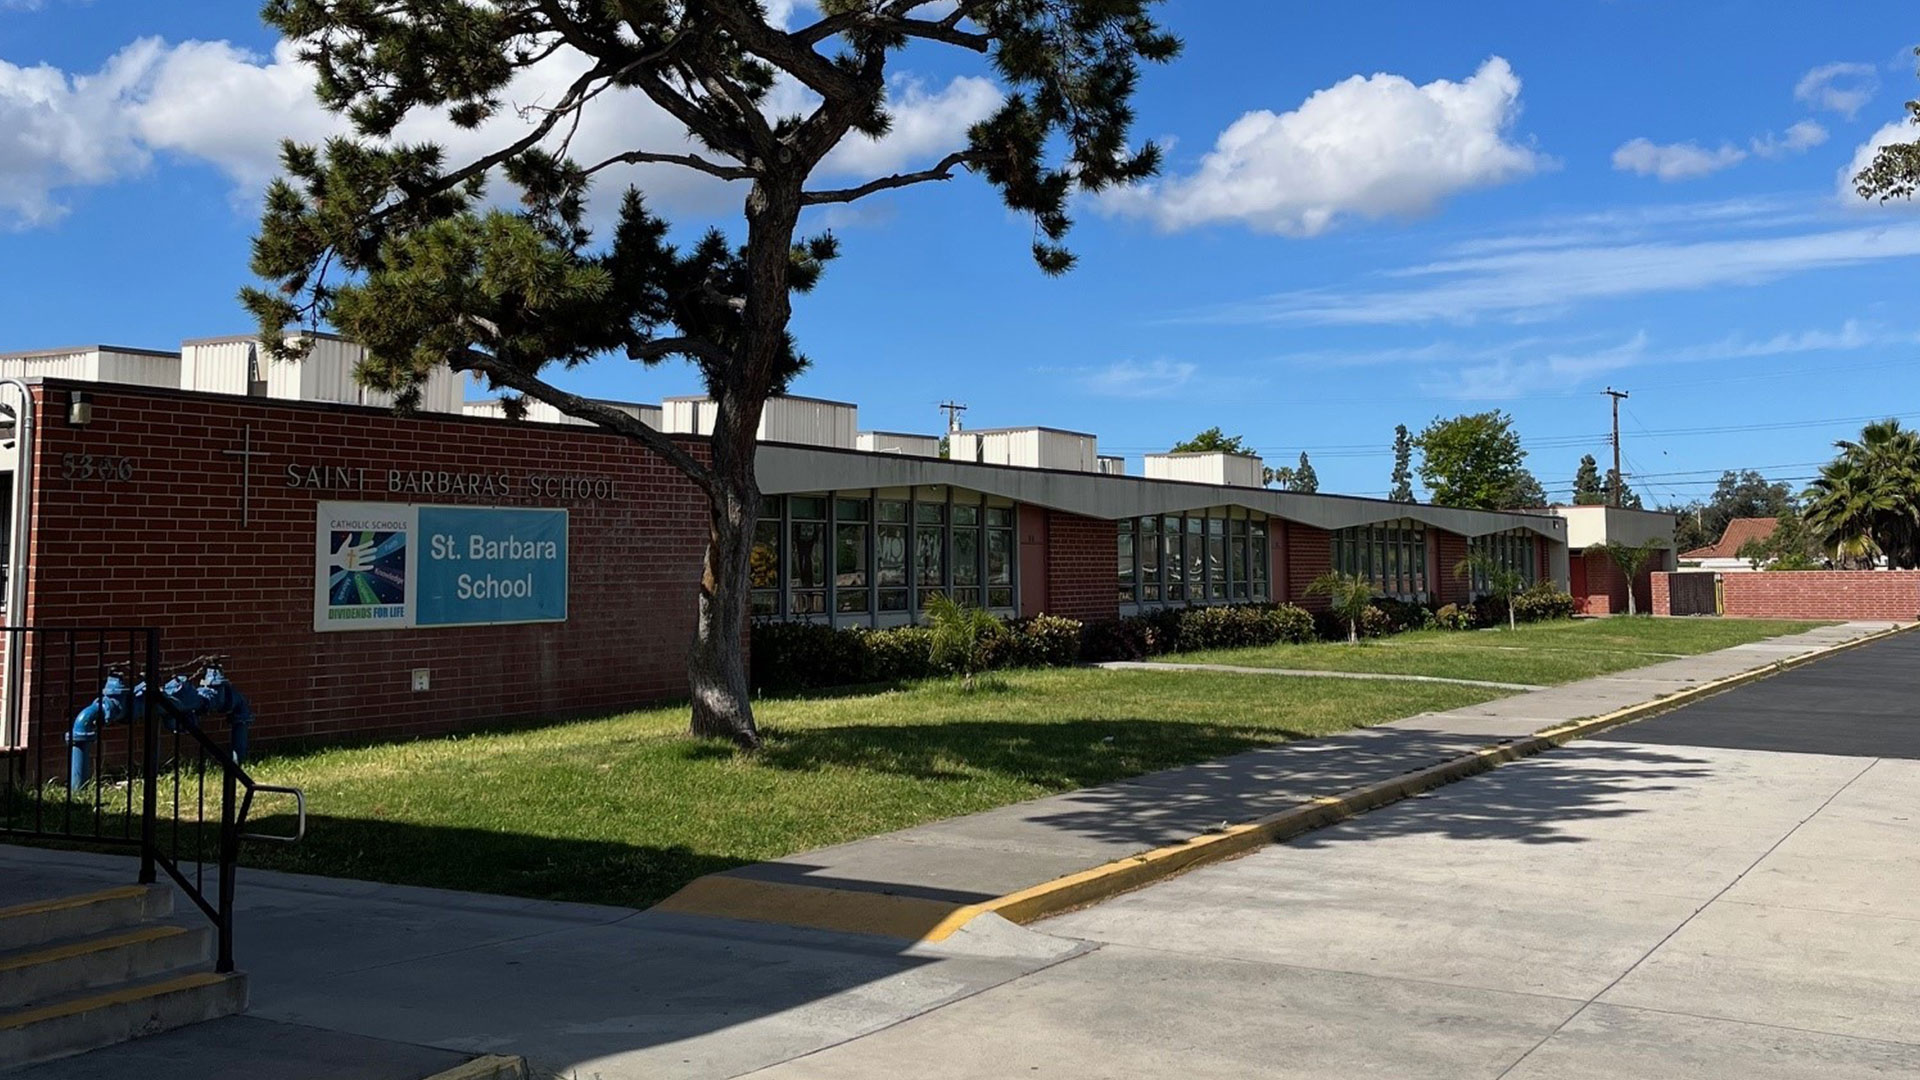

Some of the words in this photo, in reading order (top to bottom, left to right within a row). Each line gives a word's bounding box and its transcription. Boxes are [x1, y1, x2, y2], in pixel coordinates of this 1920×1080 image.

[286, 463, 368, 491] SAINT
[530, 476, 619, 500] SCHOOL
[330, 520, 370, 529] CATHOLIC
[372, 521, 407, 530] SCHOOLS
[431, 534, 461, 560] St.
[469, 534, 557, 560] Barbara
[457, 573, 532, 600] School
[328, 607, 372, 619] DIVIDENDS
[373, 607, 388, 618] FOR
[390, 606, 405, 618] LIFE
